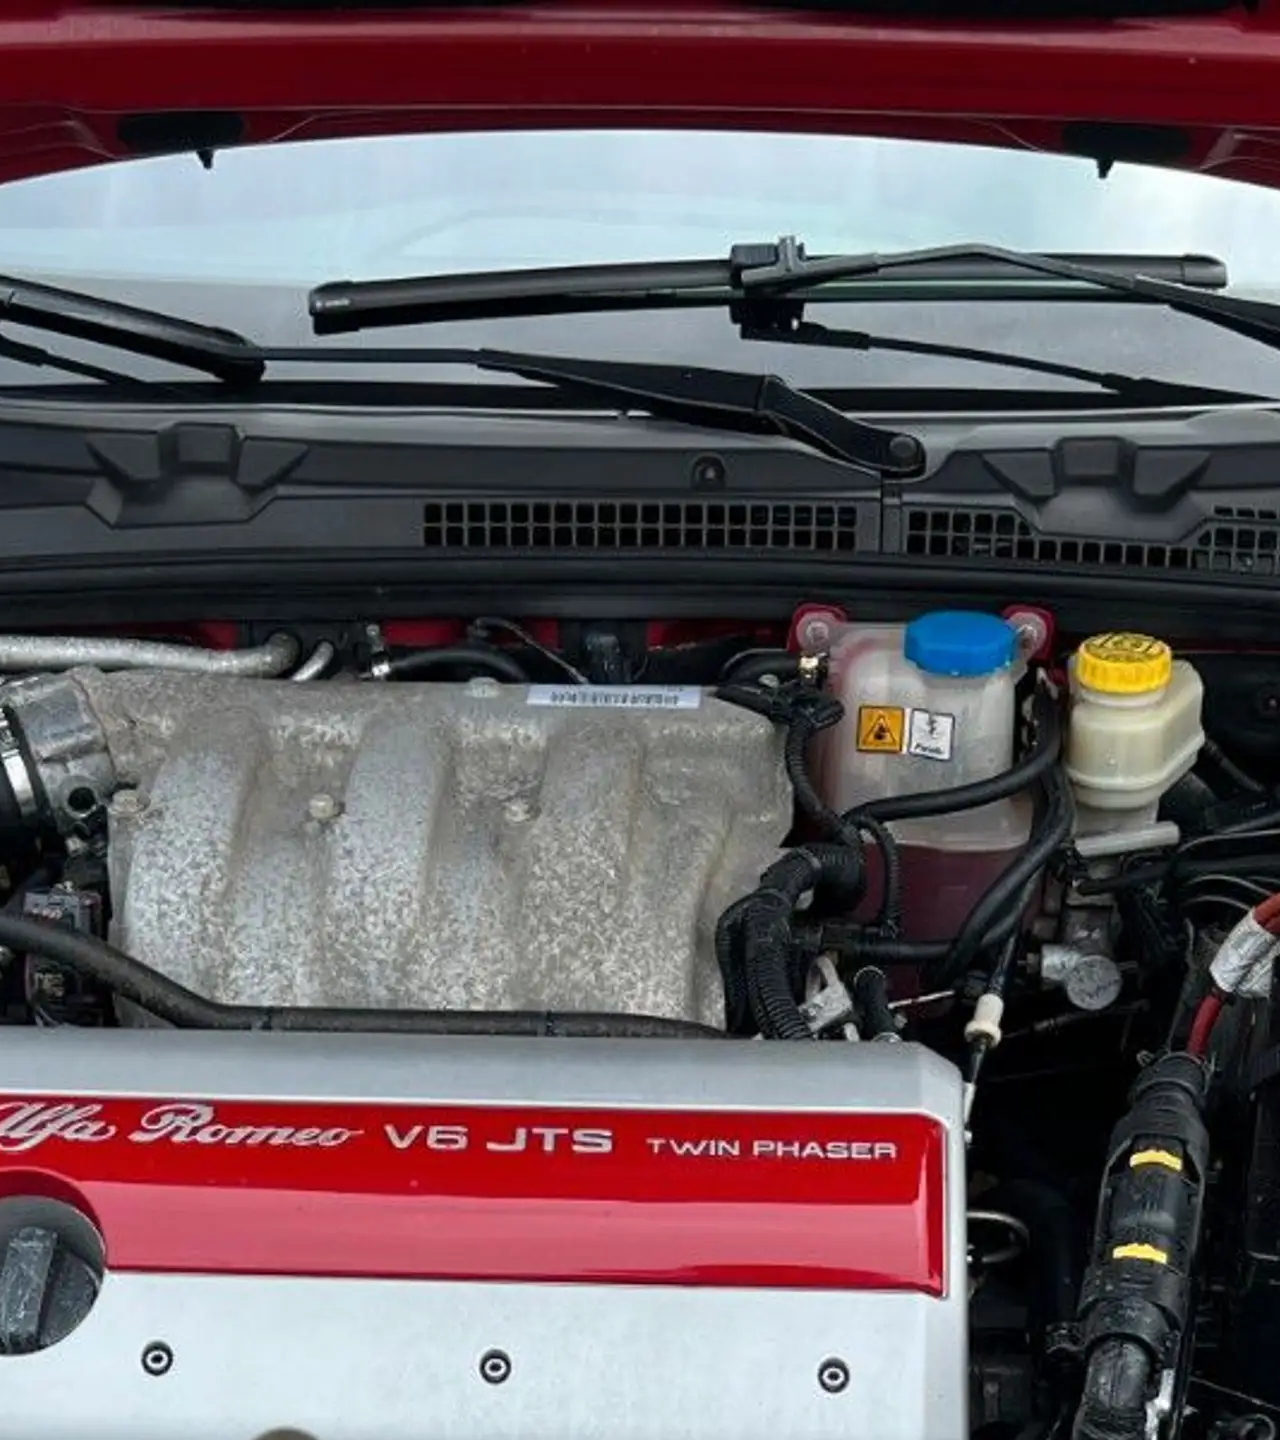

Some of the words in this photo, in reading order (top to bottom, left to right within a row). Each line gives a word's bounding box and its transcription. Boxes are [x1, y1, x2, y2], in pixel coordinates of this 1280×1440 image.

[128, 1104, 363, 1144] Romeo
[384, 1125, 468, 1151] V6
[485, 1127, 613, 1154] JTS
[647, 1137, 740, 1158] TWIN
[752, 1139, 899, 1160] PHASER
